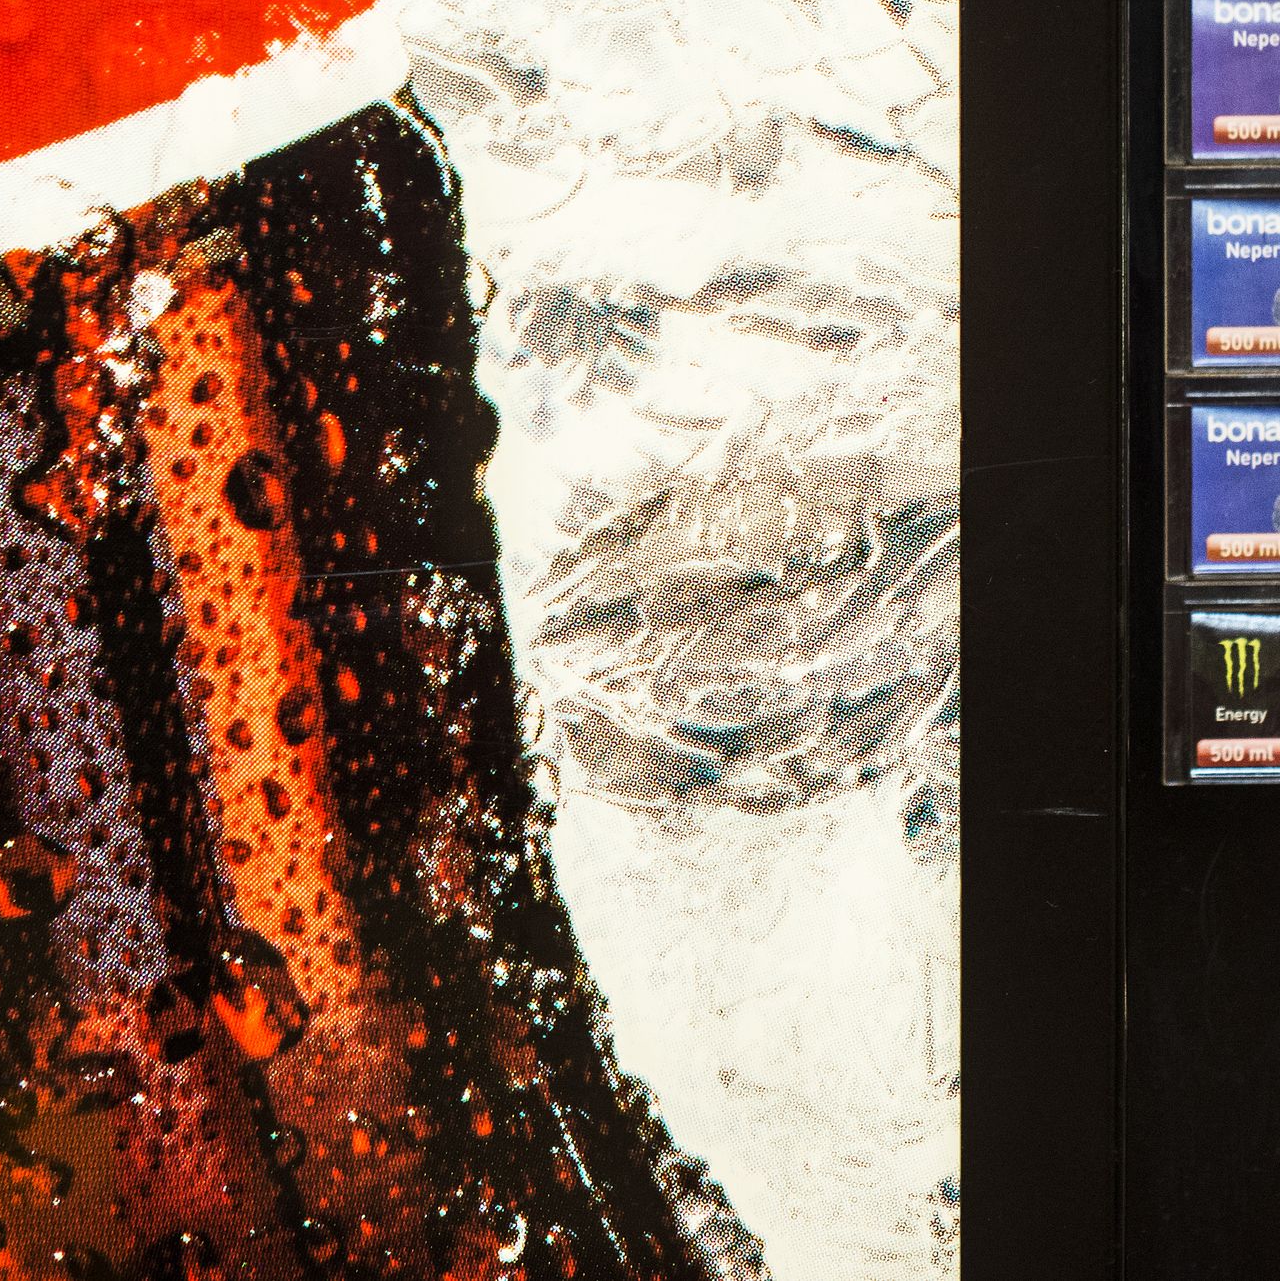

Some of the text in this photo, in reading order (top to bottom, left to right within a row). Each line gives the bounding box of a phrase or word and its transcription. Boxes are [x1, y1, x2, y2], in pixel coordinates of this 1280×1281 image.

[1226, 121, 1262, 140] 500
[1219, 334, 1254, 352] 500
[1219, 539, 1254, 558] 500
[1215, 705, 1268, 724] Energy
[1209, 744, 1275, 764] 500 ml
